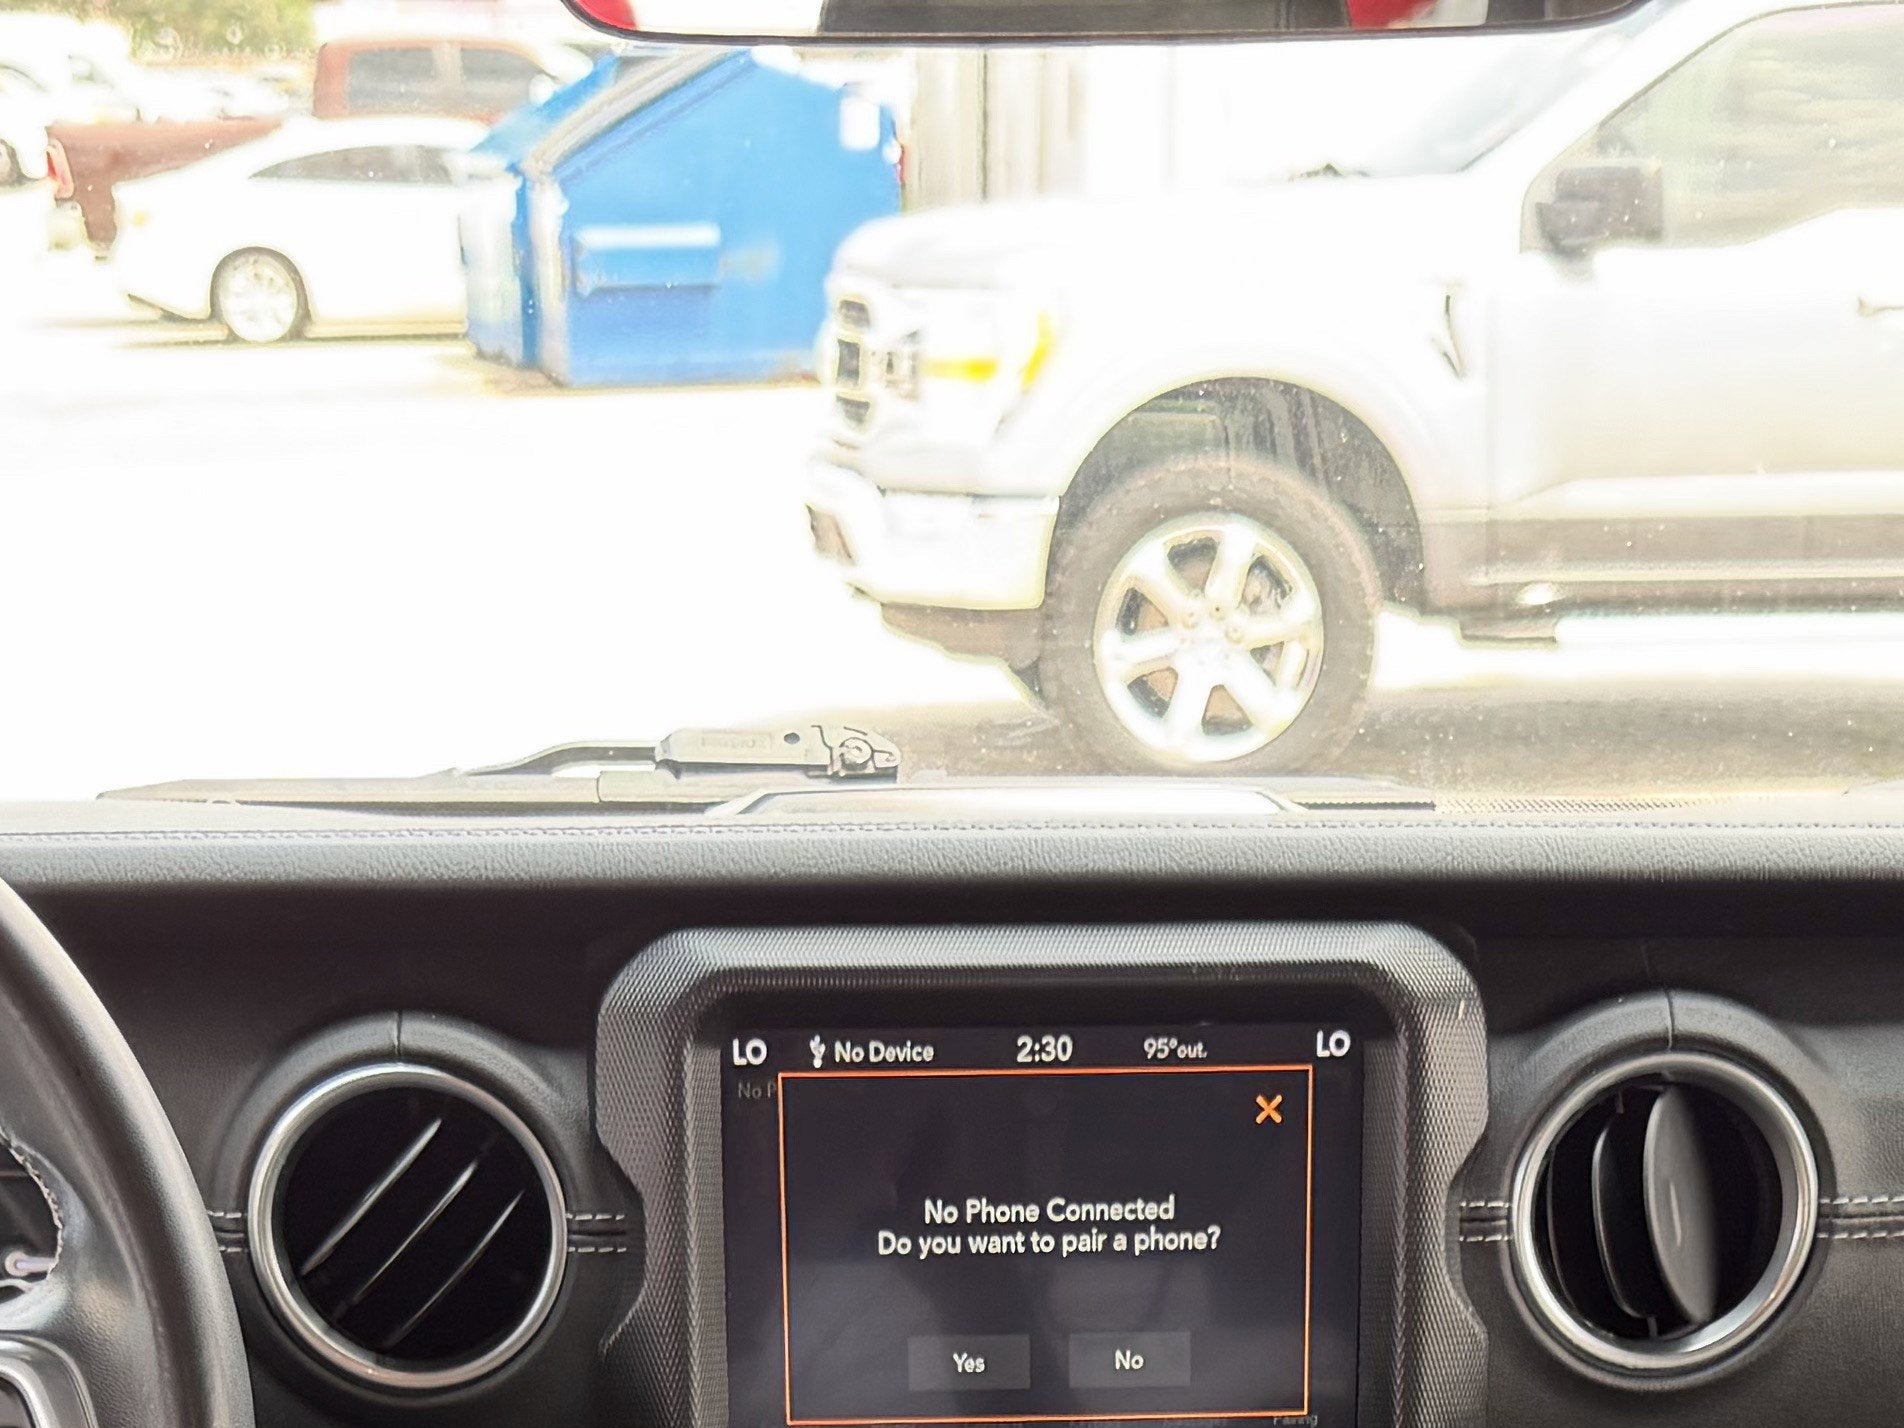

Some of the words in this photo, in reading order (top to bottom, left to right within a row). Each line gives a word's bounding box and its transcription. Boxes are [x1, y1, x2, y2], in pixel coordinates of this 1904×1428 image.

[732, 1039, 768, 1066] LO
[835, 1041, 863, 1062] No
[869, 1041, 934, 1063] Device
[1016, 1036, 1073, 1062] 2:30
[1316, 1031, 1351, 1057] LO
[924, 1199, 958, 1225] No
[966, 1198, 1039, 1224] Phone
[1047, 1195, 1175, 1223] Connected
[879, 1231, 911, 1256] Do
[919, 1235, 962, 1261] you
[969, 1231, 1025, 1254] want
[1031, 1231, 1054, 1254] to
[1063, 1230, 1107, 1258] pair
[1113, 1235, 1128, 1251] a
[1134, 1226, 1220, 1257] phone?
[952, 1352, 986, 1375] Yes
[1115, 1350, 1143, 1372] No
